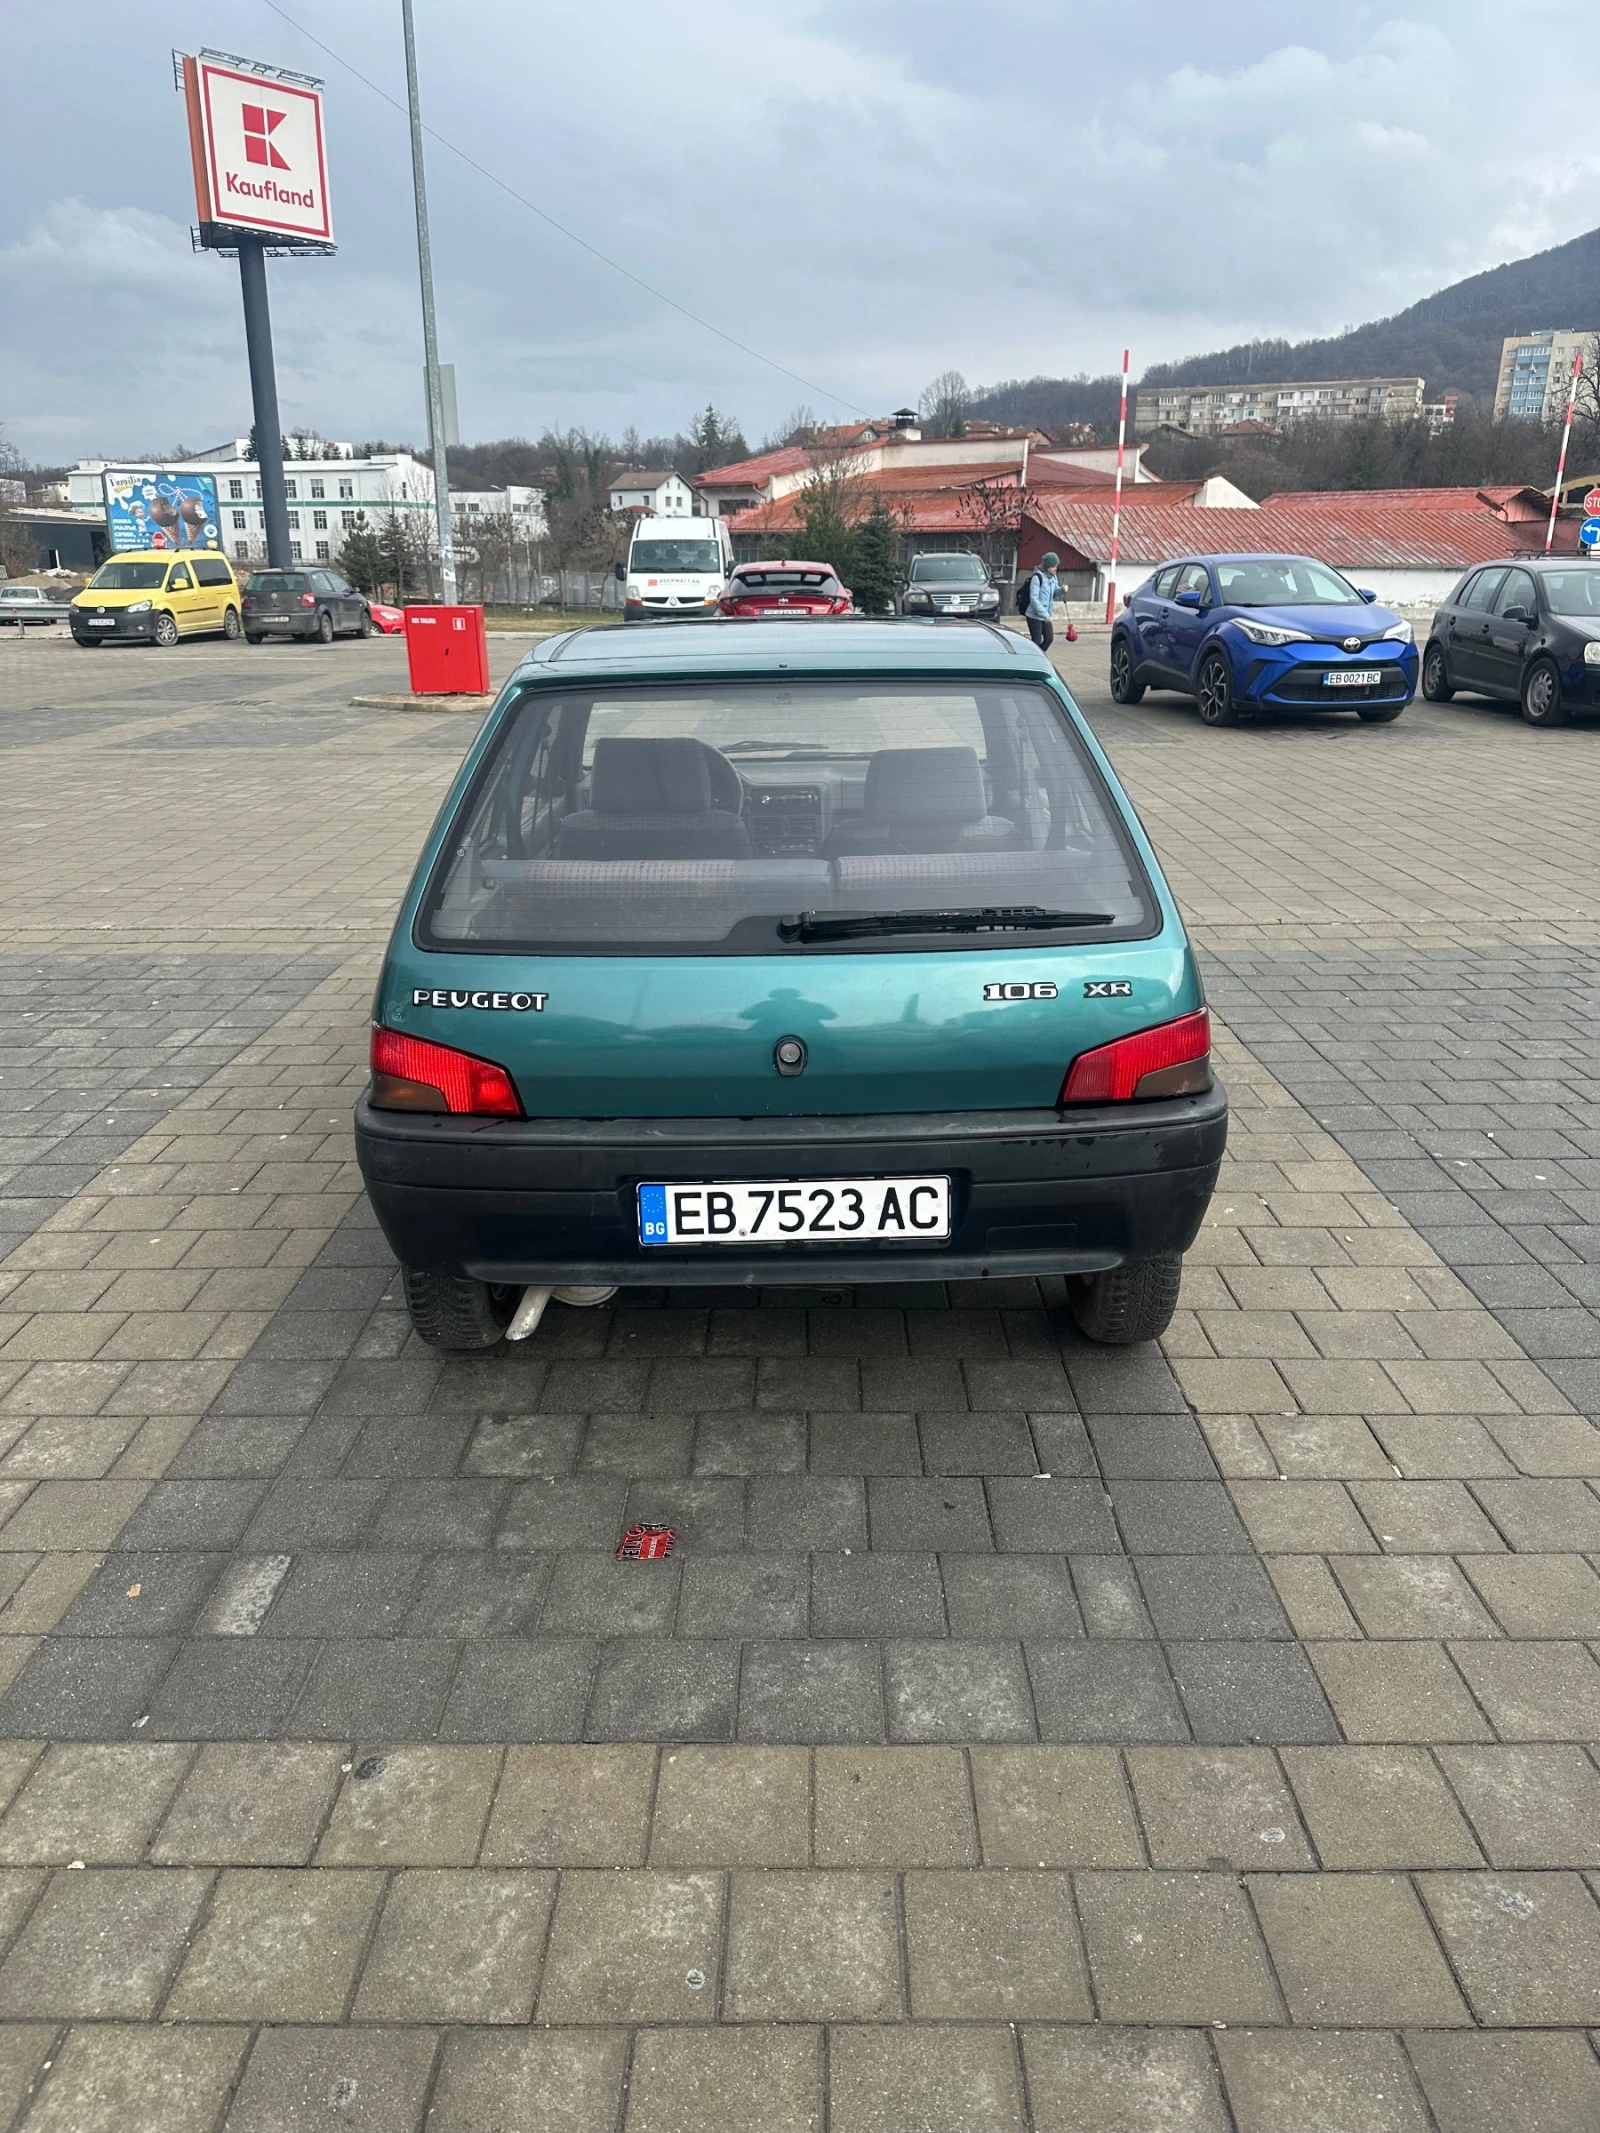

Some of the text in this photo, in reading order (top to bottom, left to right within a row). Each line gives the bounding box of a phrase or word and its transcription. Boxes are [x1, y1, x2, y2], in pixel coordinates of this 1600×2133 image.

[225, 171, 315, 209] Kaufland
[1329, 672, 1380, 684] EB 0021 BC
[413, 989, 547, 1011] PEUGEOT
[986, 982, 1132, 1000] 106 XR
[673, 1186, 939, 1235] EB 7523 AC
[644, 1222, 665, 1236] BG
